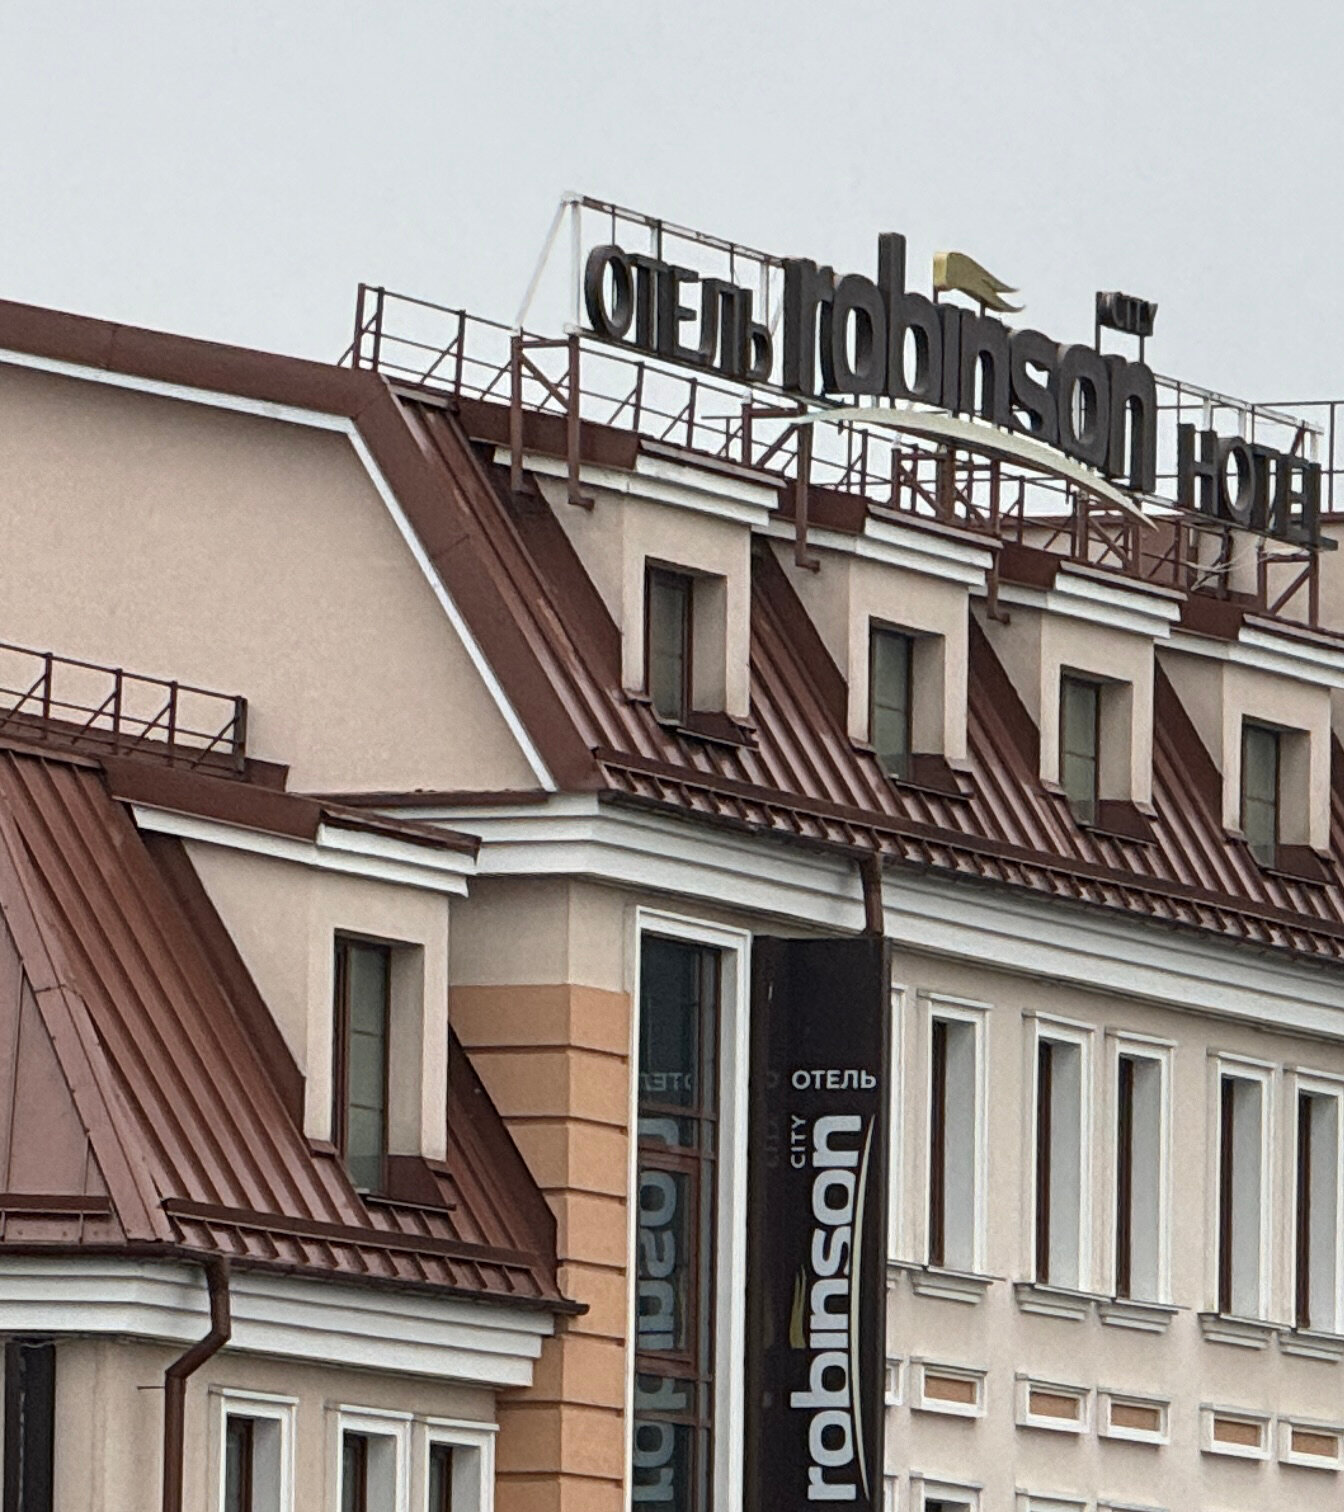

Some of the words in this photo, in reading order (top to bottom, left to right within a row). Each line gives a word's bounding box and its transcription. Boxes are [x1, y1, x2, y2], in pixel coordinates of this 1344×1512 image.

[585, 244, 773, 381] ОТЕЛЬ
[781, 232, 1156, 493] robinson
[1096, 292, 1158, 336] CITY
[1177, 423, 1338, 550] HOTEL
[790, 1114, 808, 1169] CITY
[791, 1069, 877, 1090] ОТЕЛЬ
[790, 1115, 862, 1501] robinson
